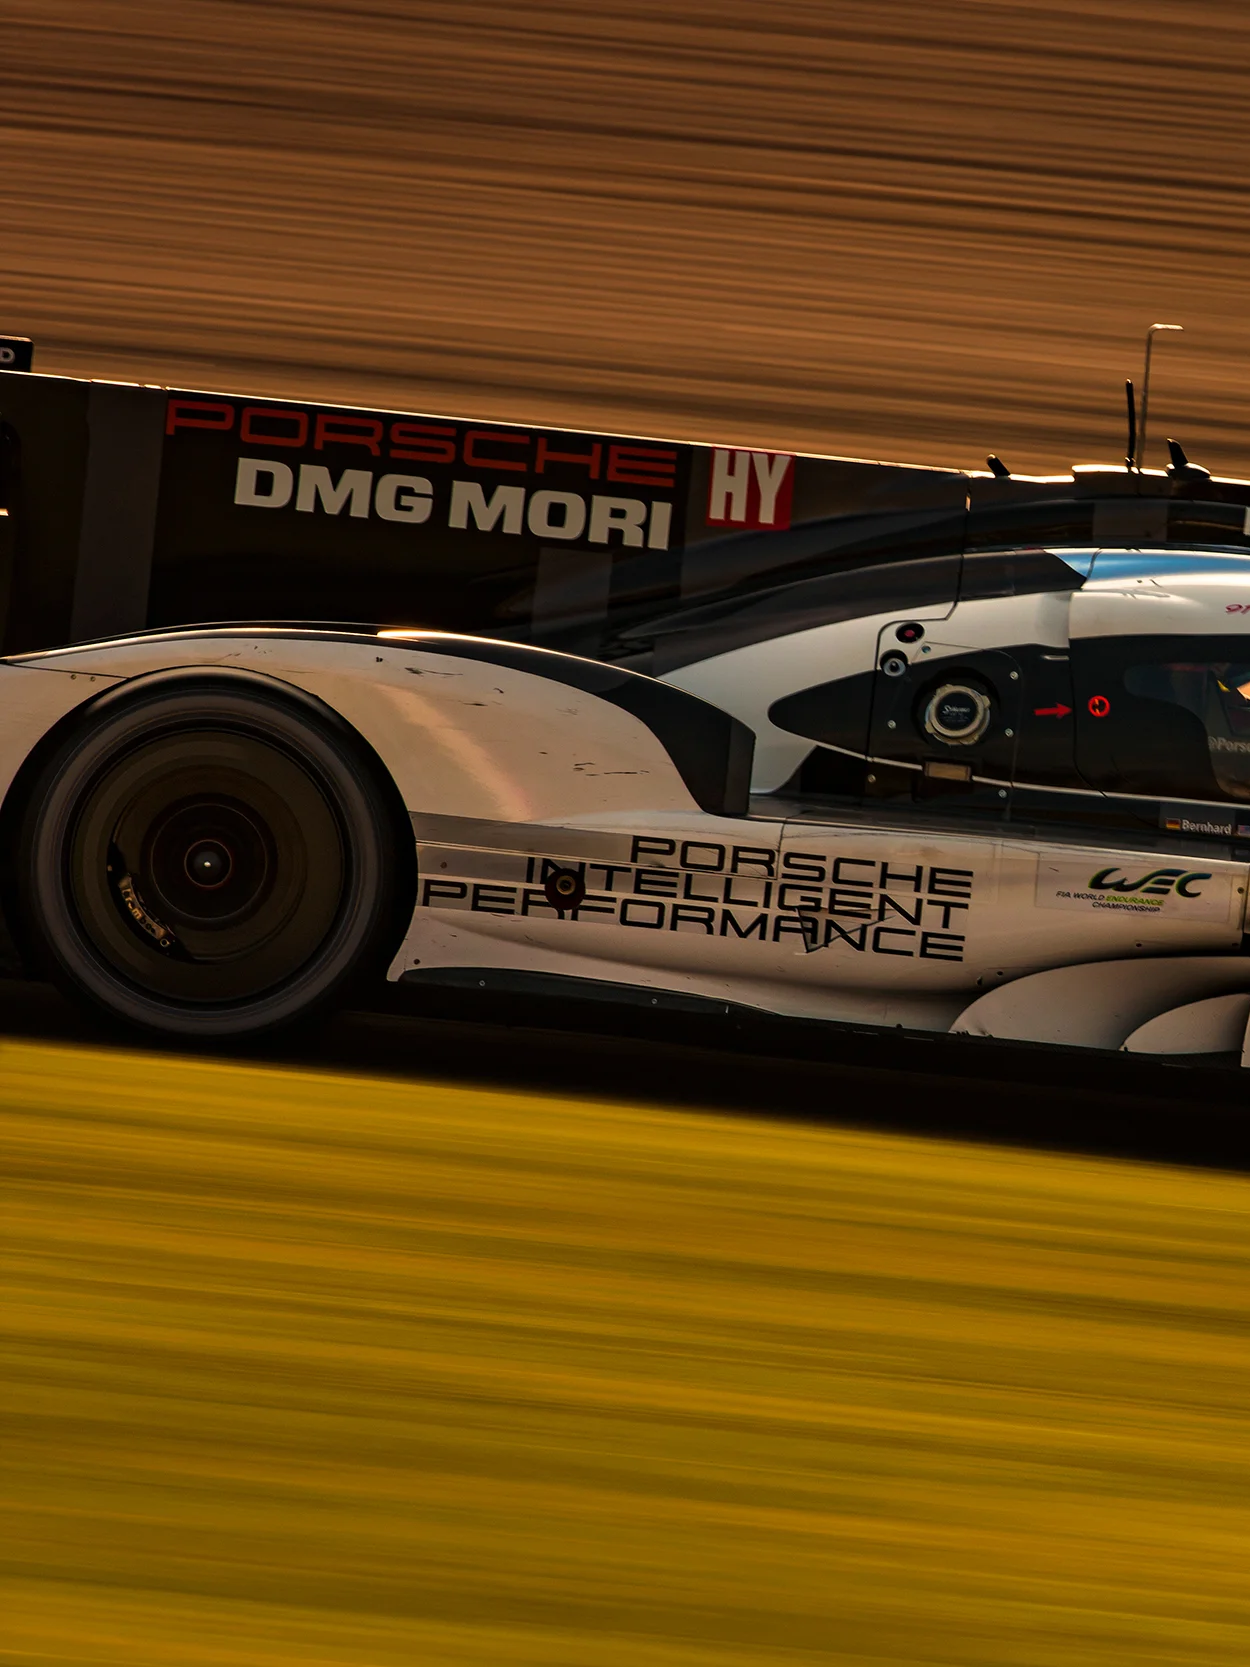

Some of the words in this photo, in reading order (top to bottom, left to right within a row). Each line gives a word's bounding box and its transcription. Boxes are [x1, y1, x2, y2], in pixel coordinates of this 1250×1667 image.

[165, 399, 678, 488] PORSCHE
[234, 457, 434, 524] DMG
[448, 480, 673, 551] MORI
[709, 449, 793, 525] HY
[1181, 819, 1232, 836] Bernhard
[526, 856, 970, 930] INTELLIGENT
[631, 835, 974, 899] PORSCHE
[1056, 890, 1071, 898] FIA
[1073, 892, 1105, 901] WORLD
[1105, 895, 1165, 906] ENDURANCE
[1088, 867, 1213, 898] WEC
[422, 879, 966, 963] PERFORMANCE
[1092, 901, 1161, 913] CHAMPIONSHIP
